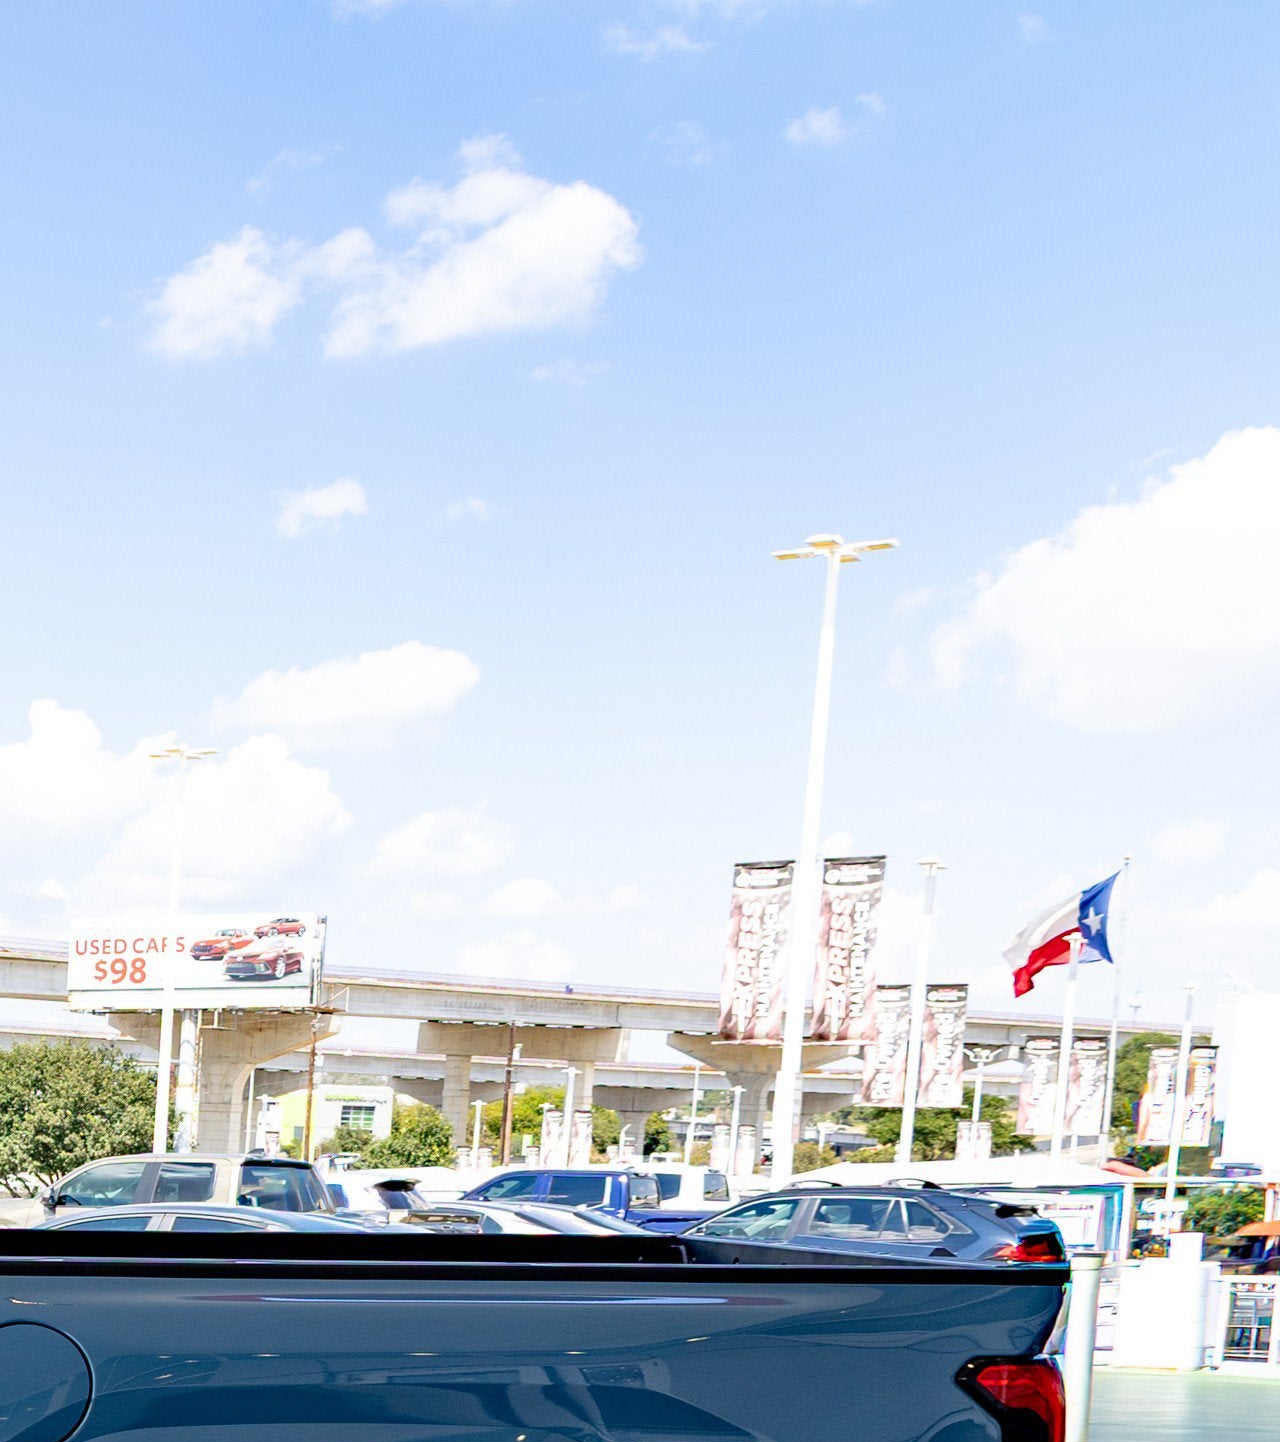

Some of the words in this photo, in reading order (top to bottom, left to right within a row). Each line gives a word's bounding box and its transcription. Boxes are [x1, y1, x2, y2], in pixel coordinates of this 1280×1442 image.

[75, 938, 127, 956] USED
[93, 957, 147, 984] $98
[731, 899, 763, 1019] EXPRESS
[824, 897, 853, 1019] EXPRESS
